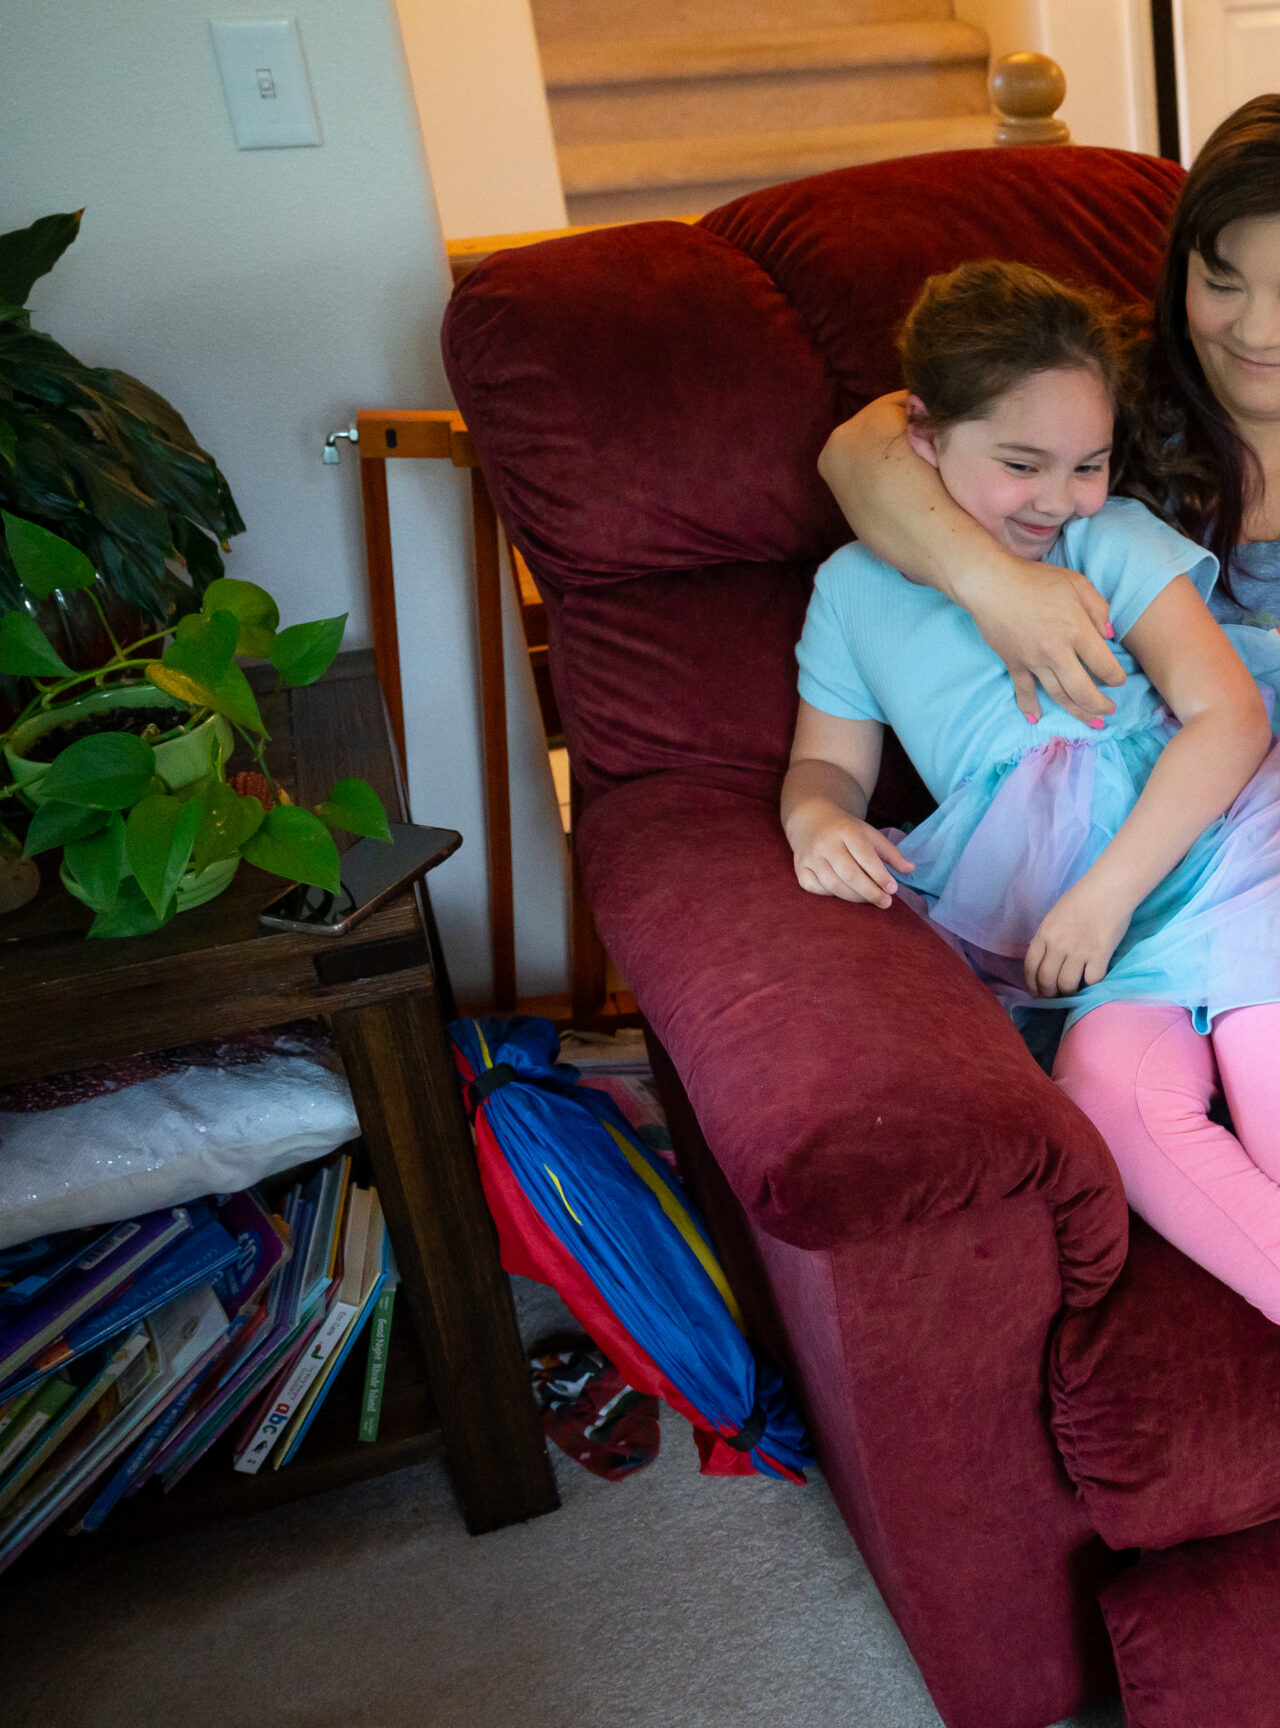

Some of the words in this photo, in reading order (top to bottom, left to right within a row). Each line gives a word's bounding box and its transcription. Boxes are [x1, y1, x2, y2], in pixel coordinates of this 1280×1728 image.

[377, 1318, 388, 1338] Good
[372, 1338, 385, 1361] Night
[370, 1363, 382, 1388] Rhode
[367, 1389, 379, 1412] Island
[263, 1403, 290, 1434] abc
